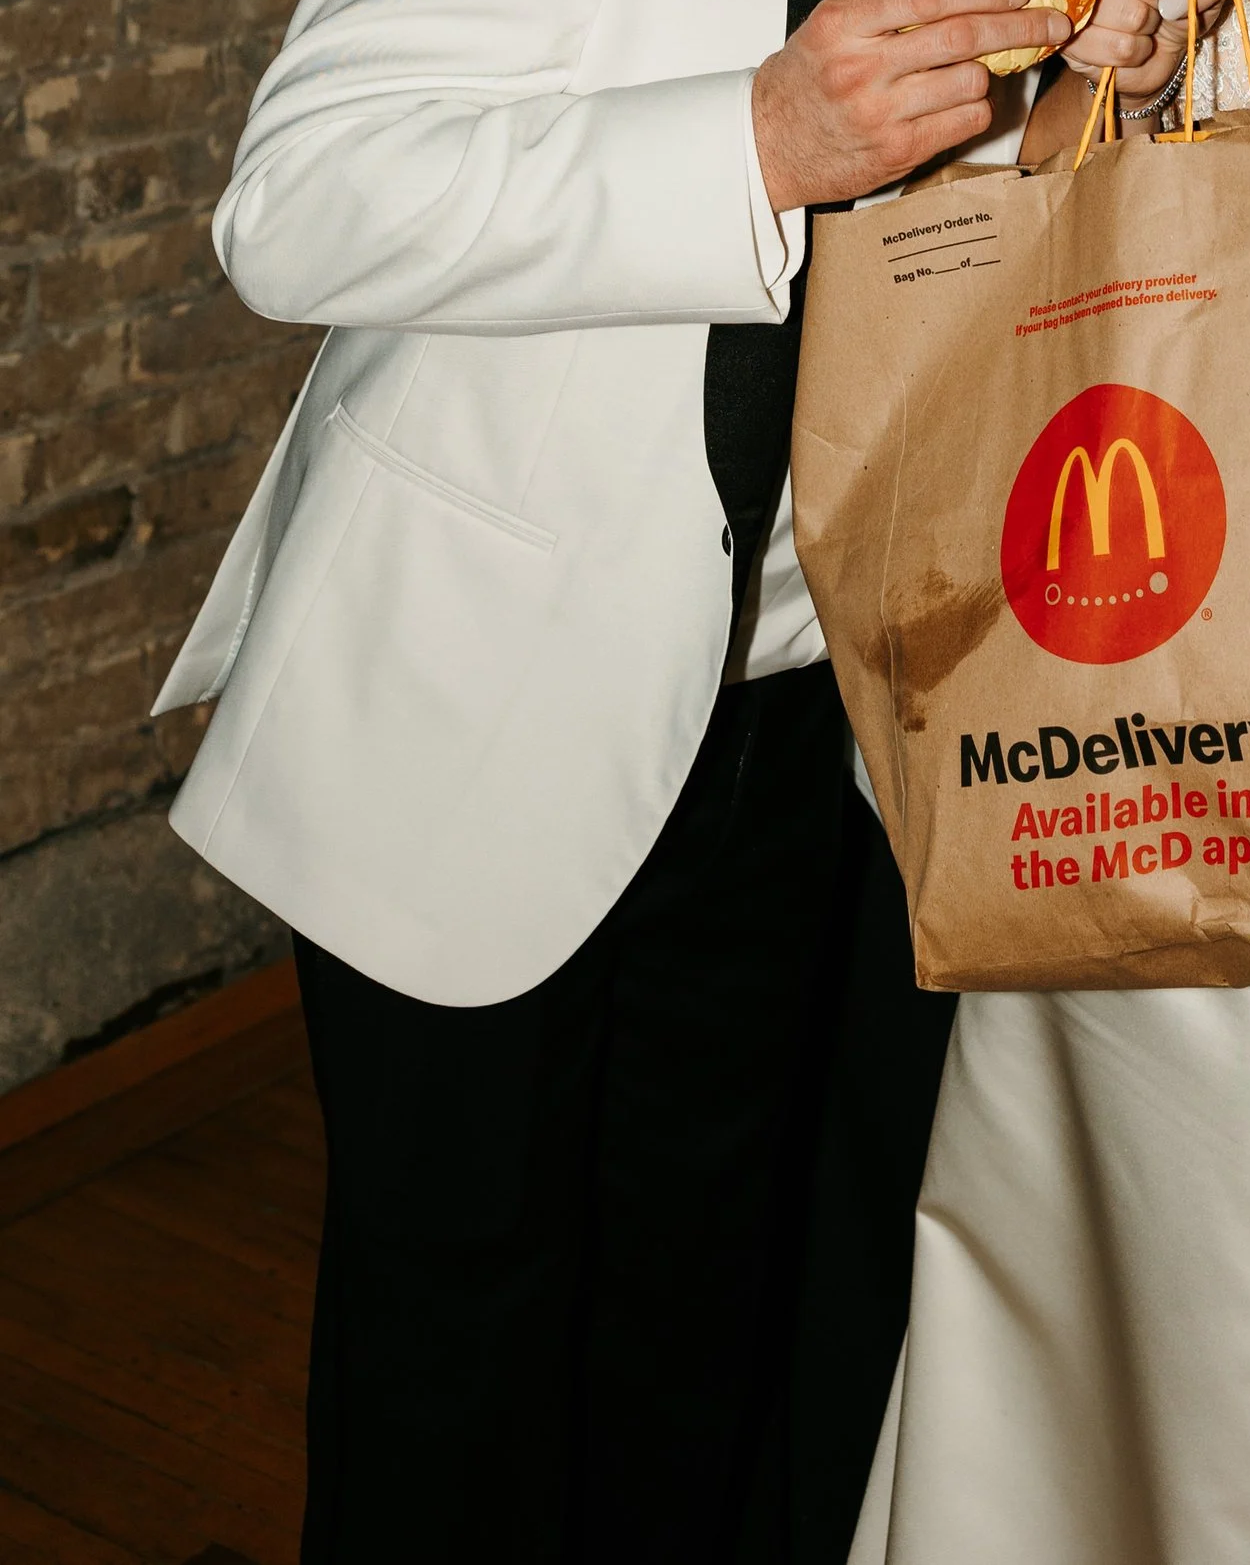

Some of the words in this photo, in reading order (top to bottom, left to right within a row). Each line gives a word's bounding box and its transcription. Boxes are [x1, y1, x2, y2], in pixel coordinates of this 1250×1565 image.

[882, 223, 942, 246] McDelivery
[944, 216, 974, 229] Order
[975, 212, 993, 223] No.
[893, 271, 915, 284] Bag
[916, 267, 934, 278] No.
[960, 257, 971, 268] of
[1023, 322, 1042, 337] your
[1043, 318, 1059, 330] bag
[1060, 313, 1074, 325] has
[1074, 307, 1091, 320] been
[1092, 296, 1123, 316] opened
[1125, 293, 1164, 306] before
[1165, 289, 1218, 302] delivery.
[1029, 302, 1057, 317] Please
[1057, 292, 1085, 310] contact
[1085, 288, 1102, 303] your
[1102, 279, 1142, 295] delivery
[1145, 273, 1197, 290] provider
[1011, 782, 1208, 841] Available
[1011, 849, 1081, 890] the
[1091, 831, 1193, 883] McD
